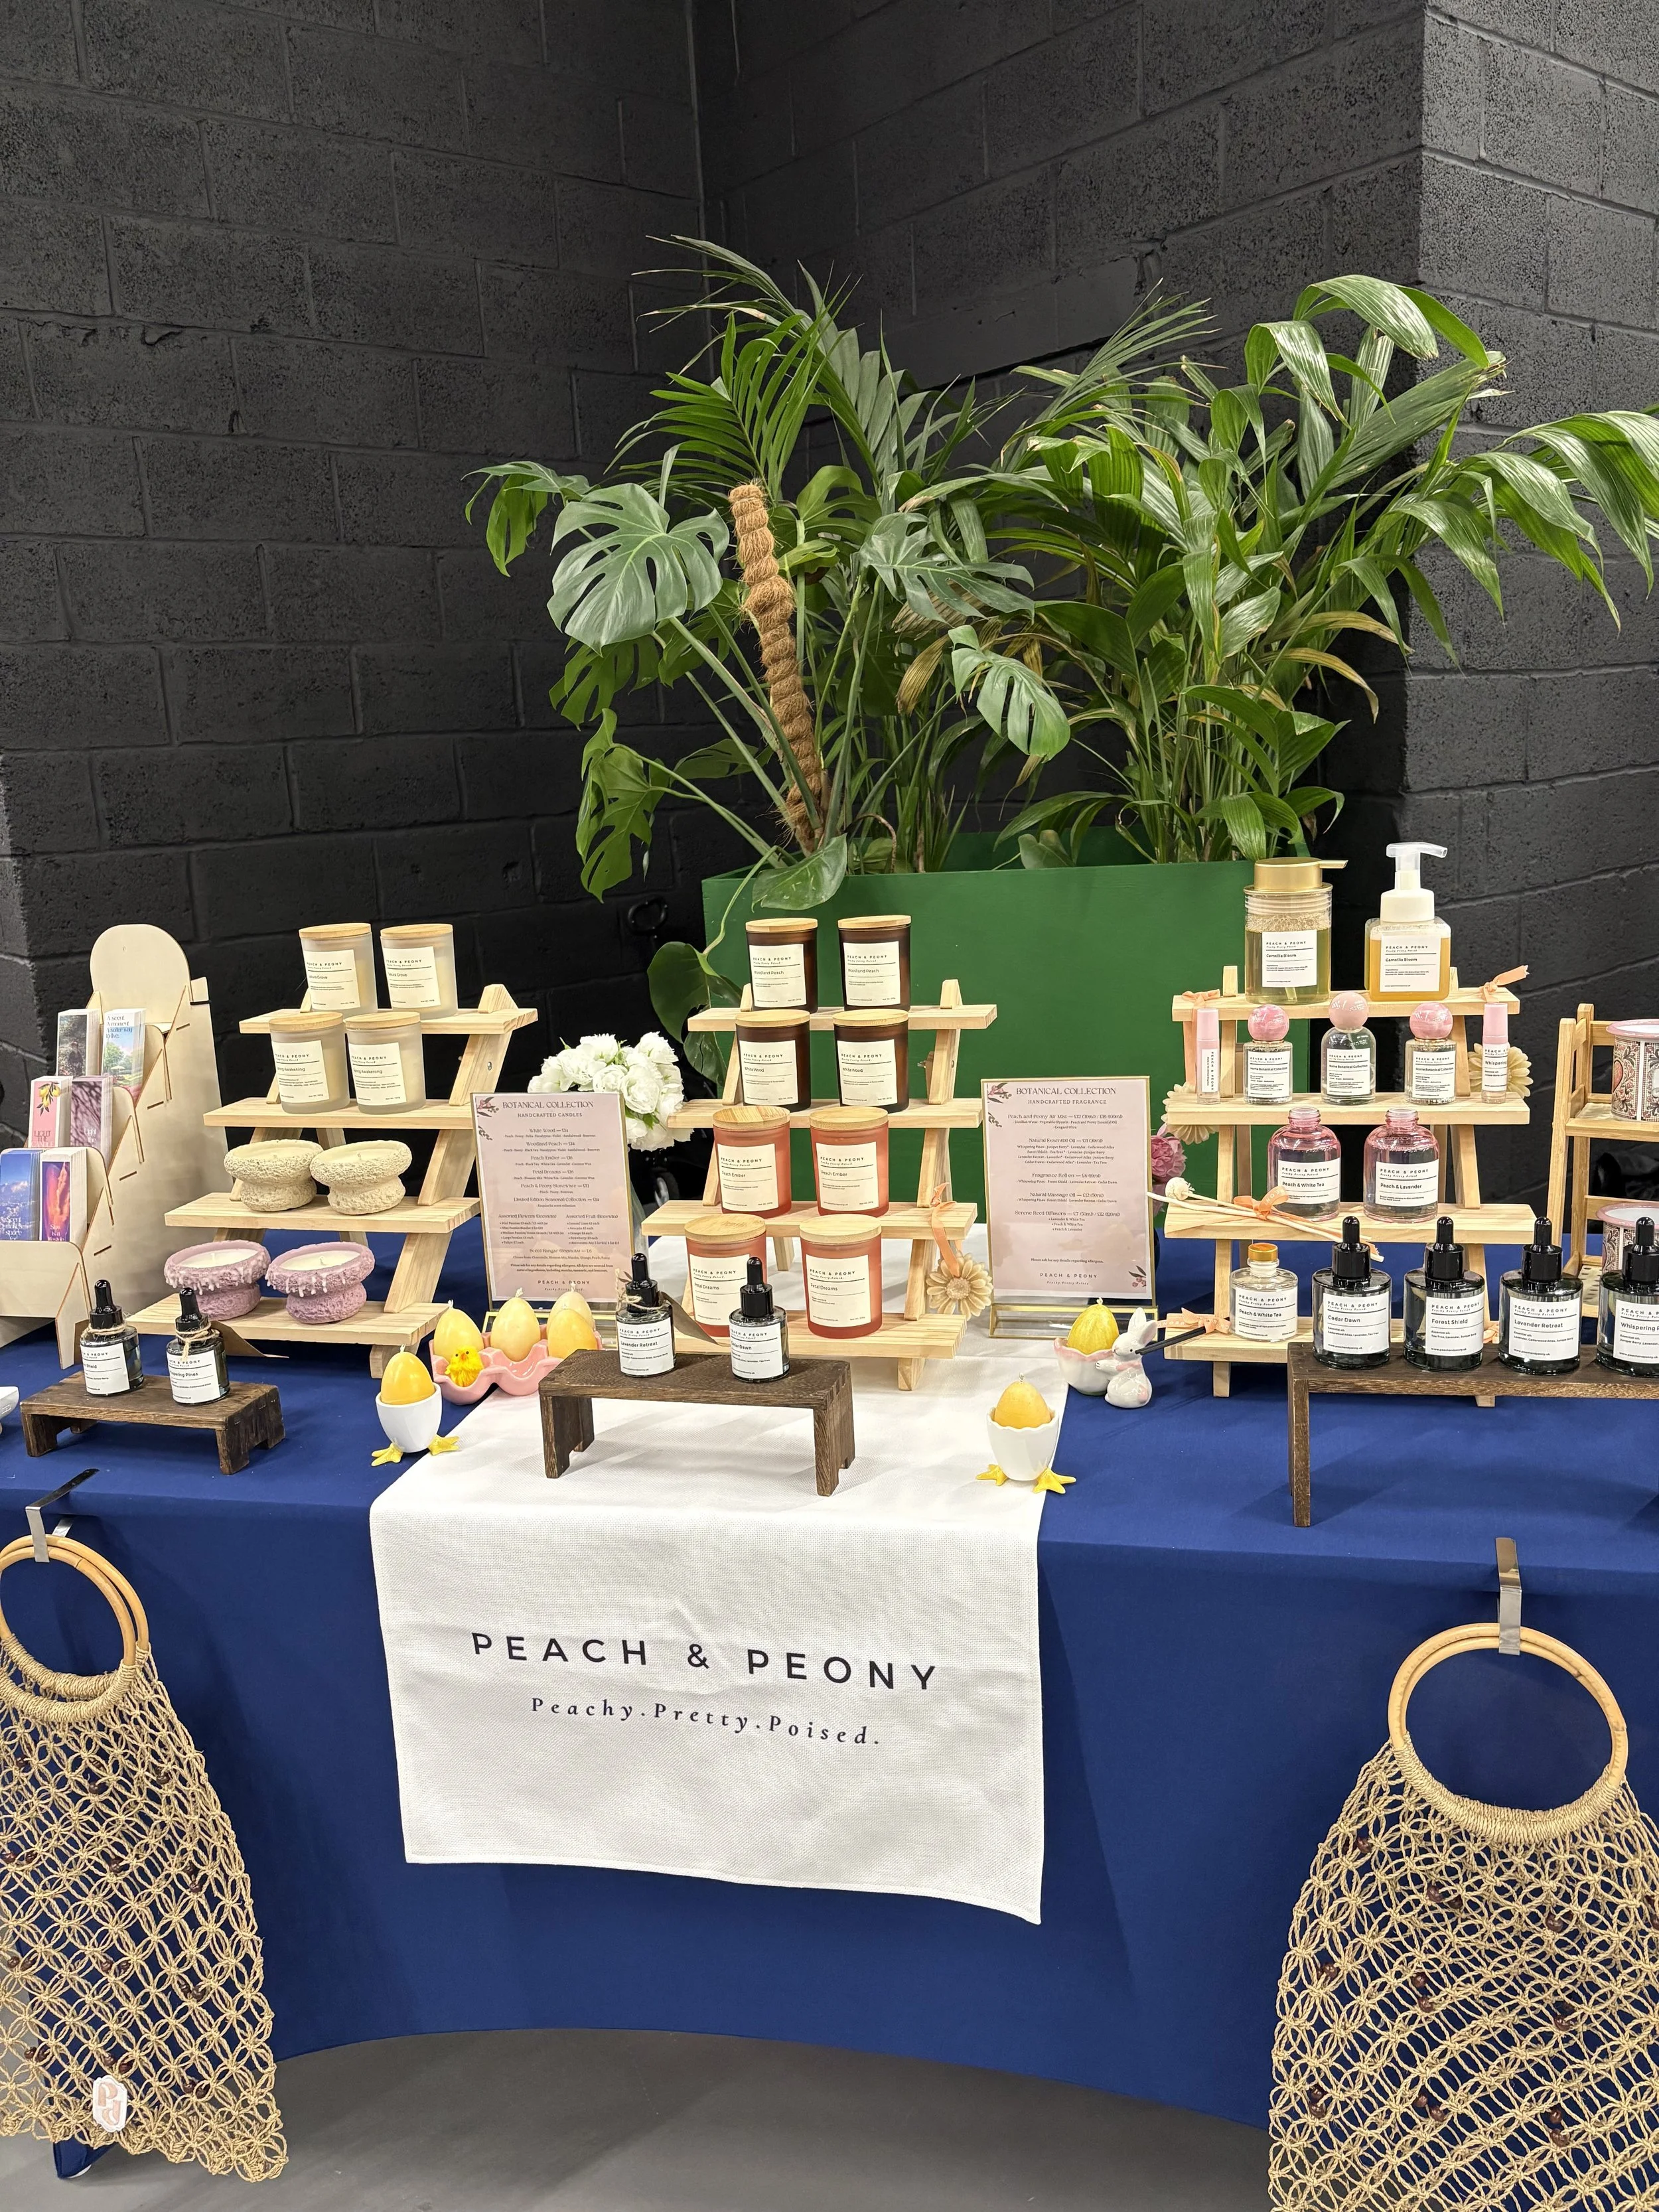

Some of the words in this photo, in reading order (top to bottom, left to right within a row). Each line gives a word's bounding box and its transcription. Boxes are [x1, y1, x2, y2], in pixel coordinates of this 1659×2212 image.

[1621, 1323, 1656, 1331] Whispering
[472, 1633, 648, 1664] PEACH
[687, 1643, 709, 1668] &
[747, 1649, 935, 1690] PEONY
